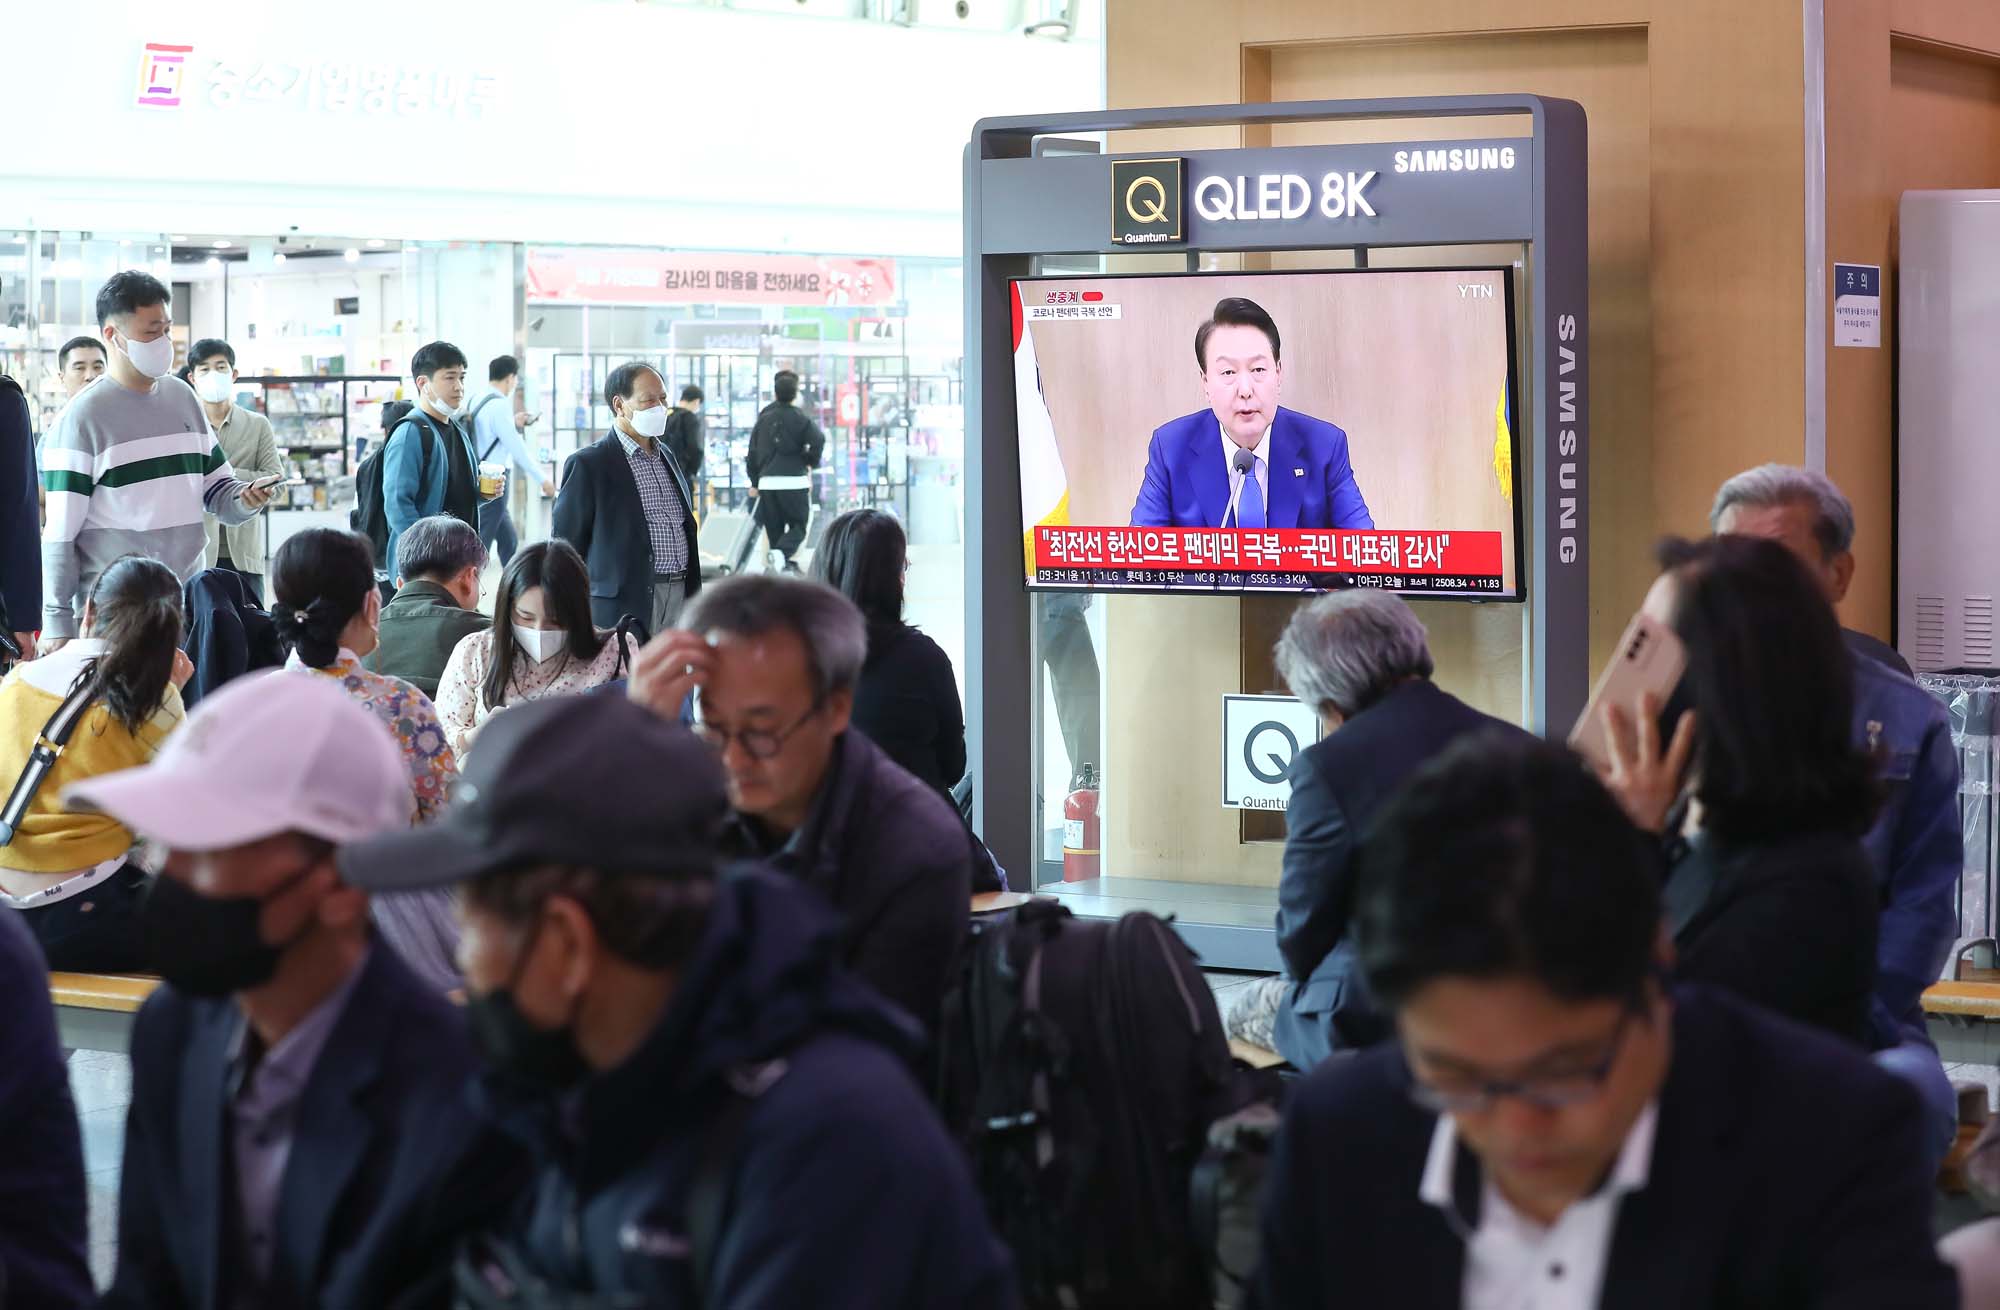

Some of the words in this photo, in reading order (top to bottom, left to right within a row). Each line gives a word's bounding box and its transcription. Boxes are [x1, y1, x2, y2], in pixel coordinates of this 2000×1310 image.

[1394, 147, 1516, 173] SAMSUNG
[1194, 174, 1312, 221] QLED
[1320, 171, 1378, 218] 8K
[1124, 232, 1168, 243] Quantum
[665, 269, 711, 289] 감사의
[715, 270, 759, 290] 마음을
[763, 272, 821, 292] 전하세요
[1046, 290, 1079, 304] 생중계
[1457, 284, 1493, 298] YTN
[1032, 308, 1055, 318] 코로나
[1080, 306, 1096, 317] 극복
[1097, 306, 1113, 317] 선언
[1558, 314, 1577, 564] SAMSUNG
[1106, 530, 1181, 563] 헌신으로
[1183, 532, 1240, 566] 팬데믹
[1343, 534, 1400, 569] 대표해
[1039, 569, 1066, 581] 09:34
[1107, 571, 1119, 581] LG
[1126, 571, 1144, 582] 롯데
[1167, 571, 1184, 583] 두산
[1194, 573, 1207, 583] NC
[1231, 573, 1240, 583] kt
[1250, 573, 1269, 583] SSG
[1292, 574, 1308, 584] KIA
[1357, 575, 1382, 587] [야구]
[1384, 576, 1402, 588] 오늘
[1410, 578, 1427, 587] 코스피
[1435, 578, 1467, 588] 2508.34
[1477, 579, 1500, 588] 11.83
[1243, 796, 1289, 809] Quantu
